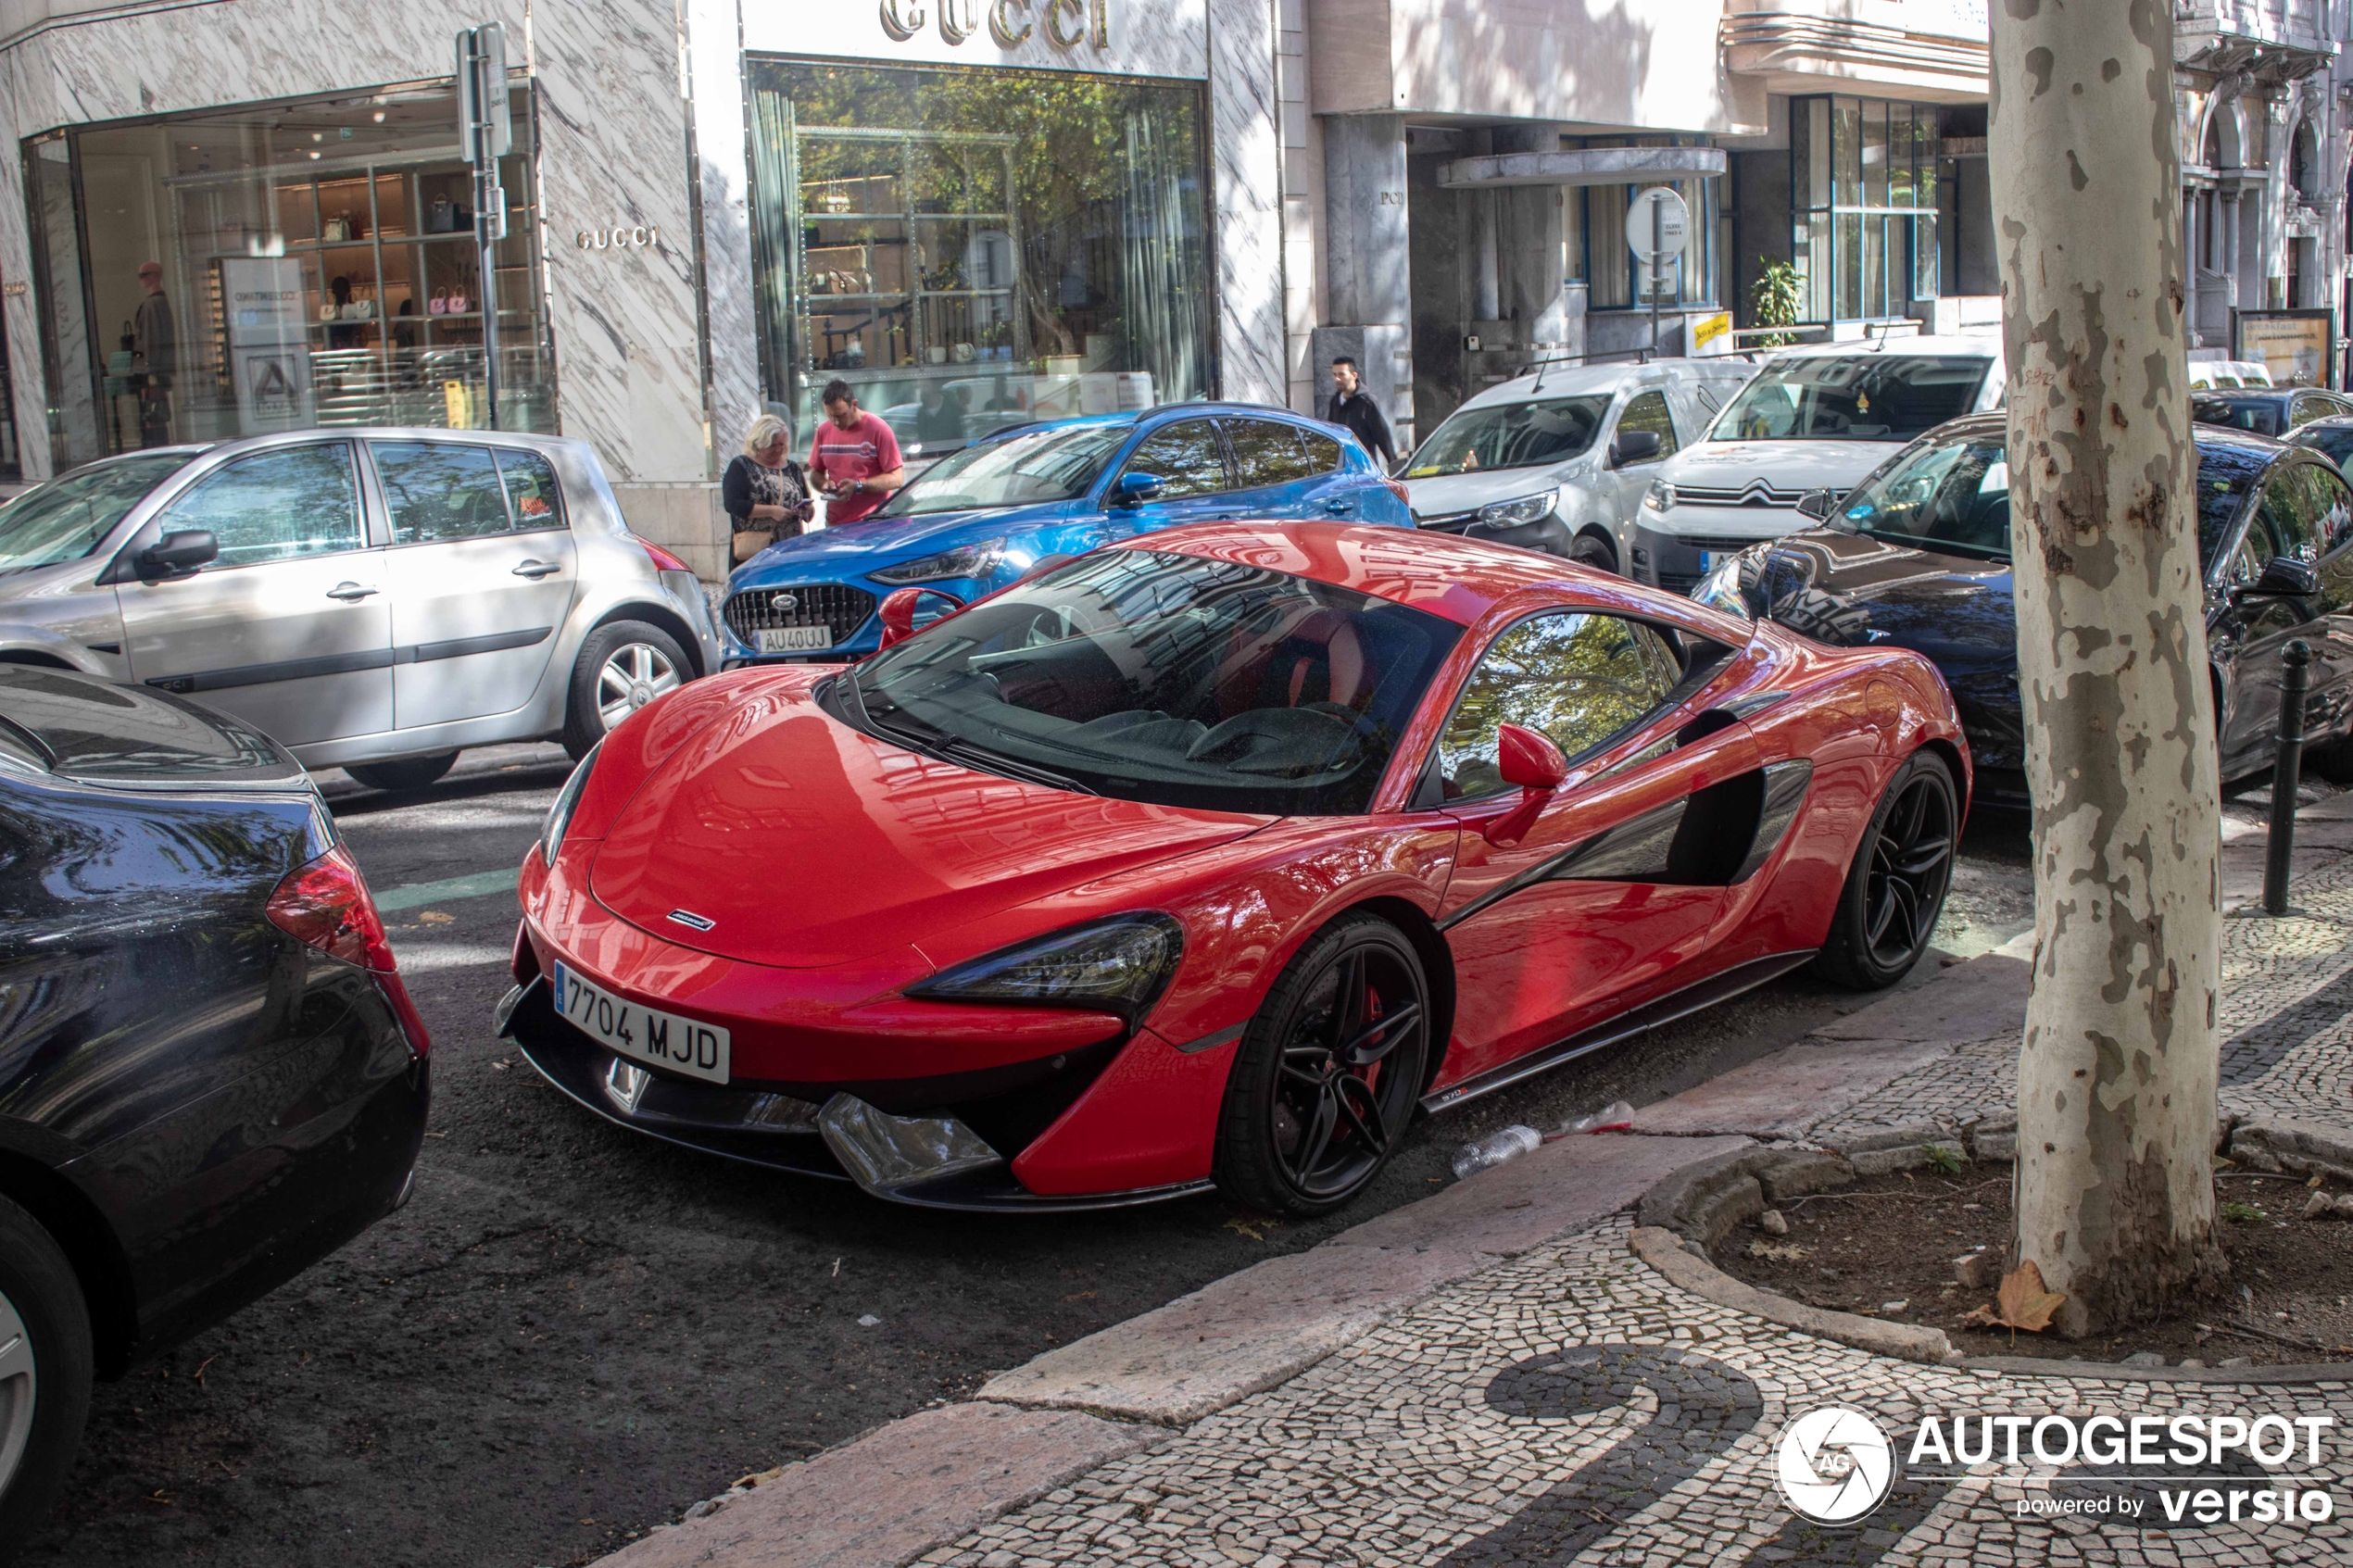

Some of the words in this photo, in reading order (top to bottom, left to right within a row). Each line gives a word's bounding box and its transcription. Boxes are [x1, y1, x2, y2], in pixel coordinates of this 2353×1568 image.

[879, 0, 1109, 49] GUCCI
[576, 225, 660, 250] GUCCI
[2246, 321, 2296, 332] Breakfast
[569, 975, 634, 1046] 7704
[648, 1014, 718, 1070] MJD
